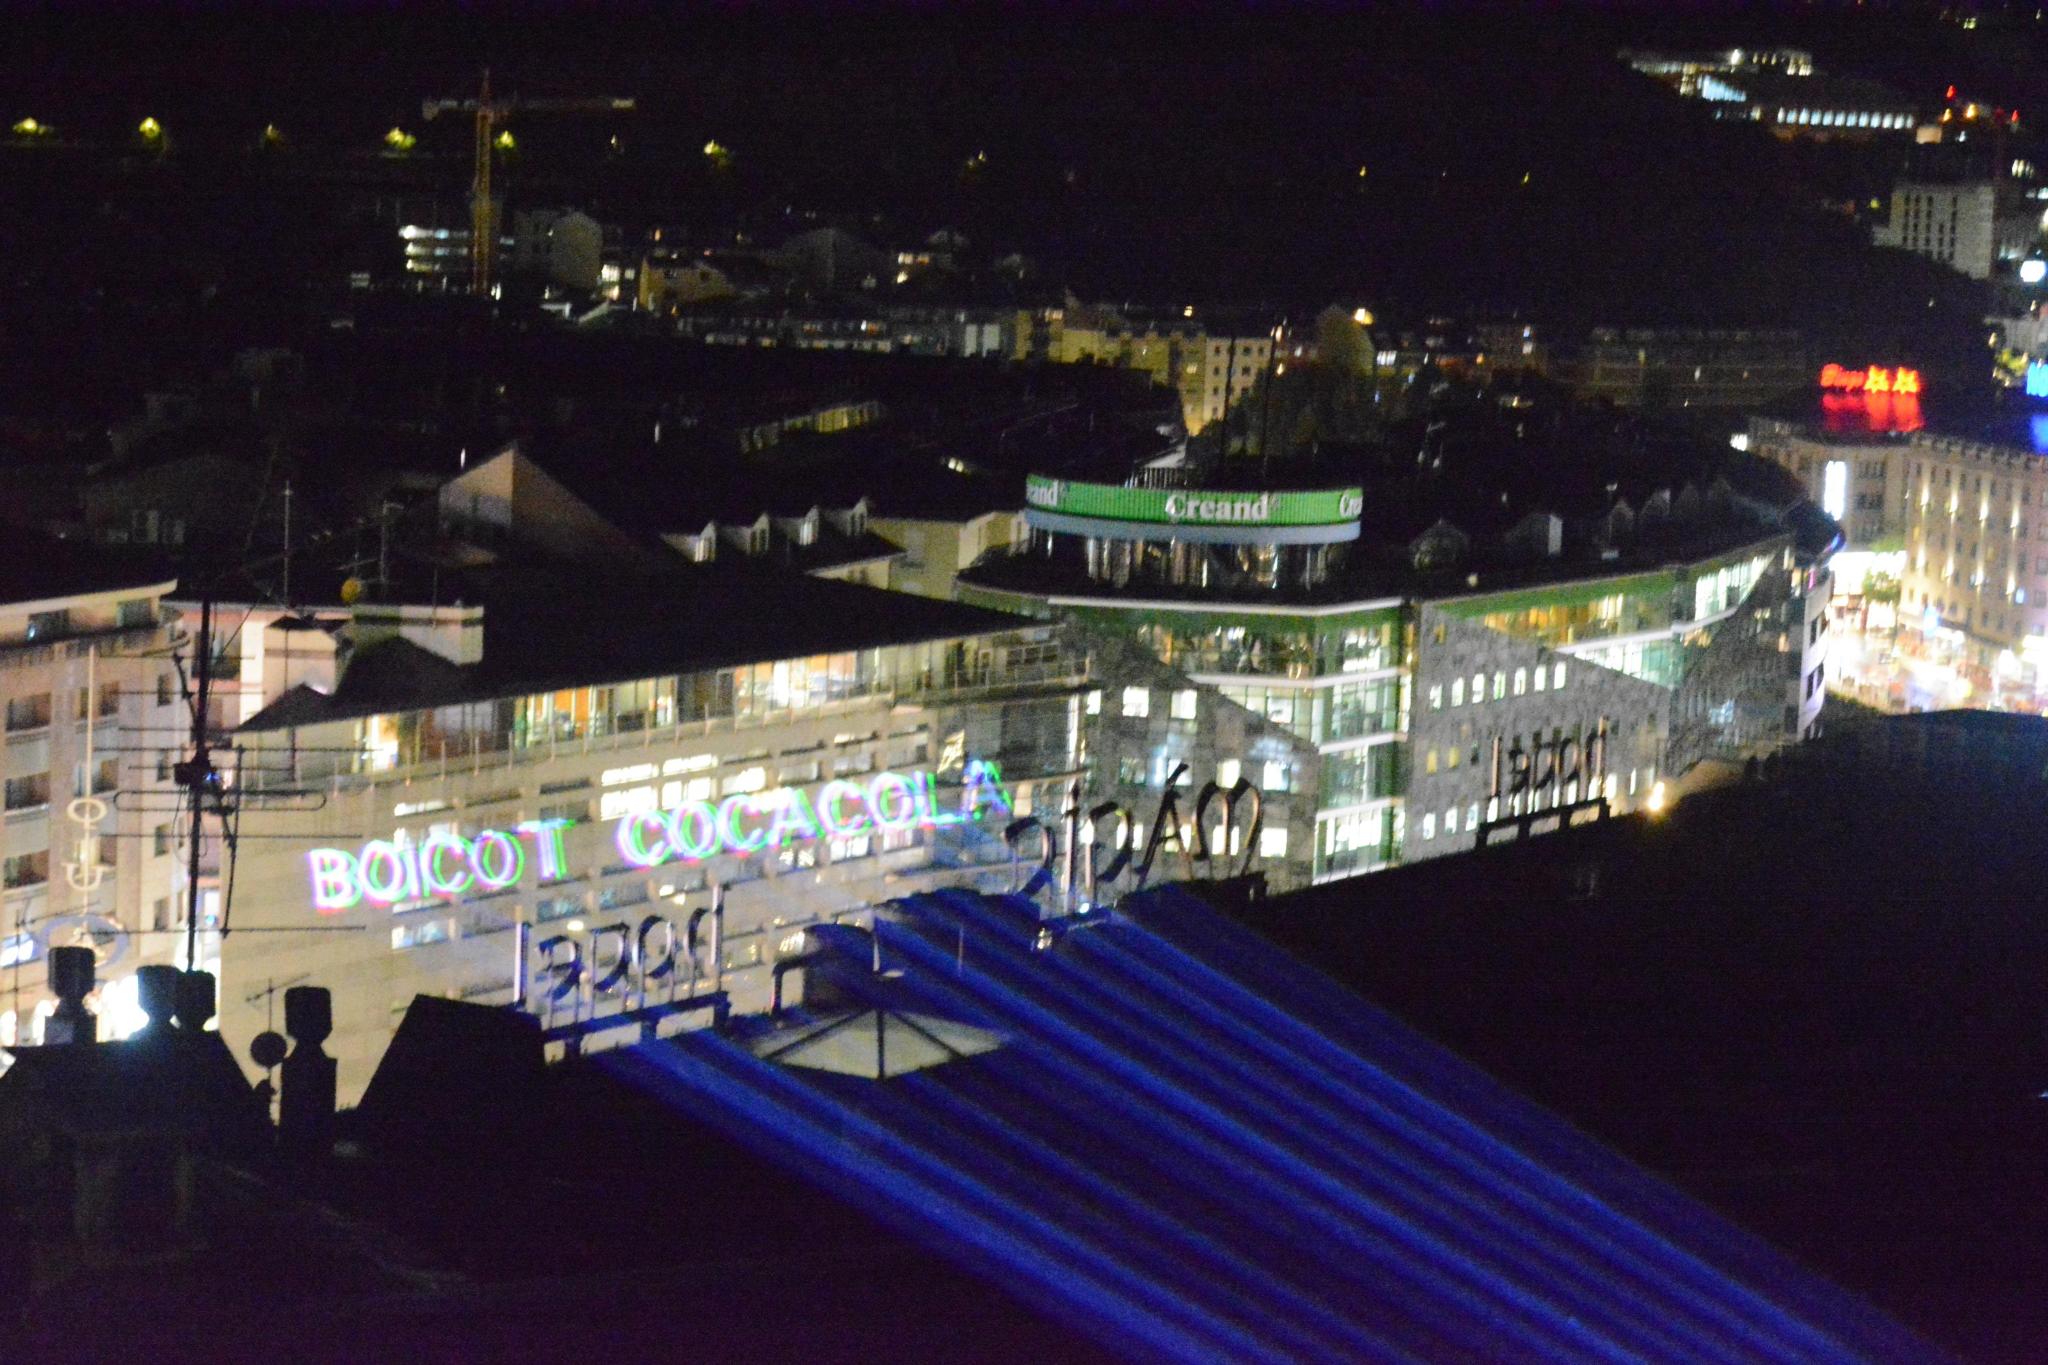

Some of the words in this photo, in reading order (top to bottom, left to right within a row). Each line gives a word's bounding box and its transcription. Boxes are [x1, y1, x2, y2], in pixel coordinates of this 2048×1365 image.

[1165, 492, 1267, 520] Creand
[307, 817, 576, 914] BOICOT
[615, 759, 1015, 868] COCACOLA
